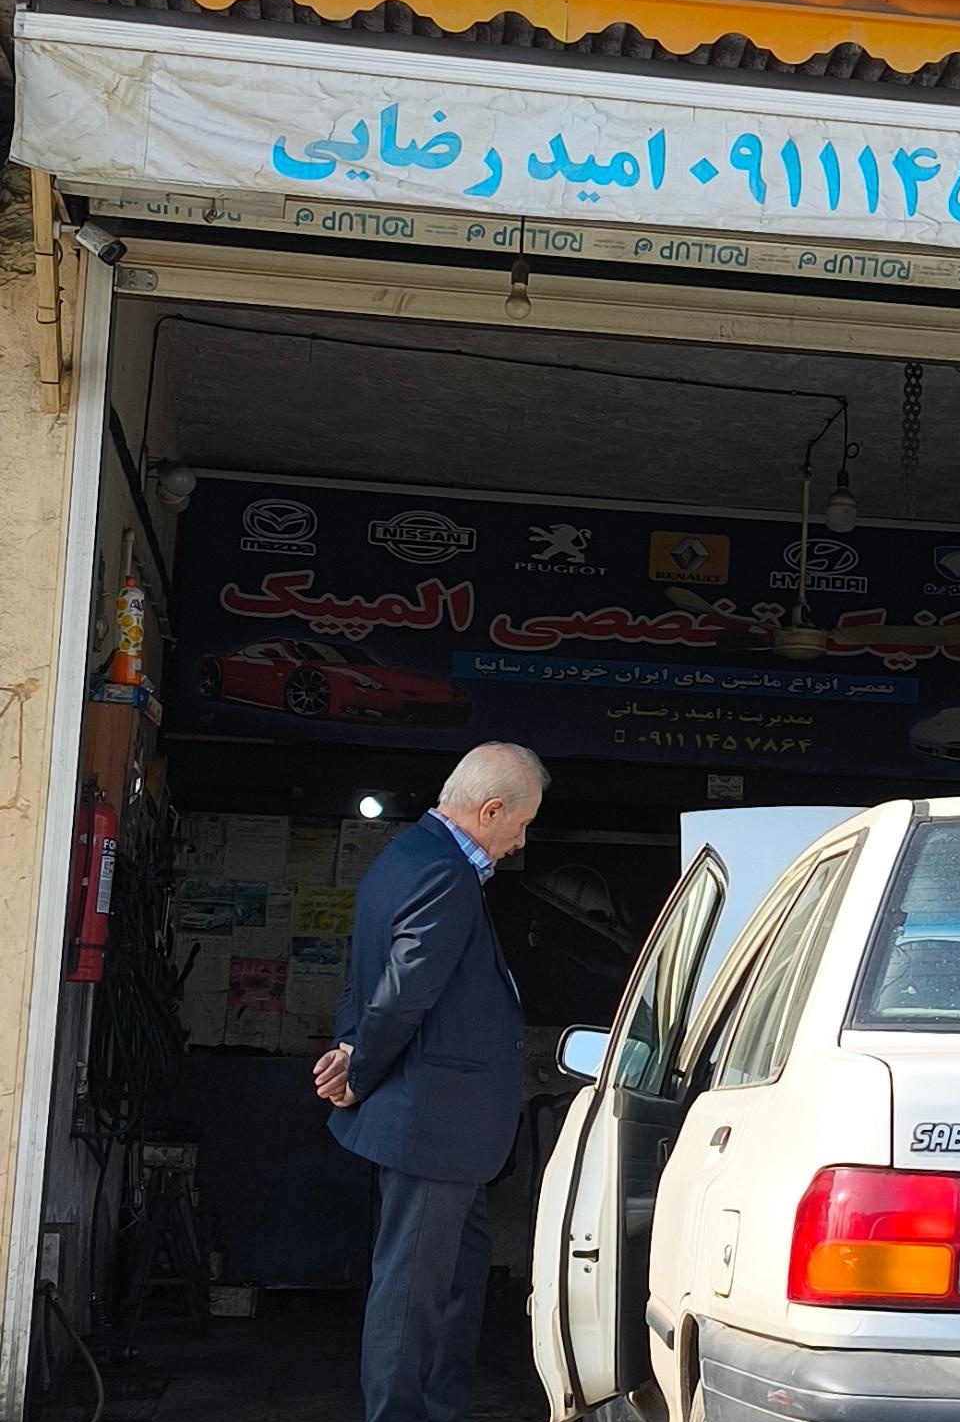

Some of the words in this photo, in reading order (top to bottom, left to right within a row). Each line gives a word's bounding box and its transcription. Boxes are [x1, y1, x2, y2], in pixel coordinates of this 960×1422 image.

[272, 103, 502, 197] رضایی
[528, 128, 666, 203] امید
[321, 209, 416, 239] ROLLUP
[492, 222, 584, 253] ROLLUP
[660, 240, 749, 267] ROLLUP
[824, 252, 912, 279] ROLLUP
[382, 527, 462, 544] NISSAN
[514, 561, 608, 576] PEUGEOT
[656, 571, 721, 583] RENAULT
[769, 571, 868, 593] HYUNDAI
[220, 569, 474, 641] المپیک
[474, 656, 521, 674] سایپا
[614, 667, 668, 684] ایران
[721, 673, 782, 688] ماشین
[788, 676, 838, 693] انواع
[845, 681, 895, 696] تعمیر
[685, 707, 721, 722] امید
